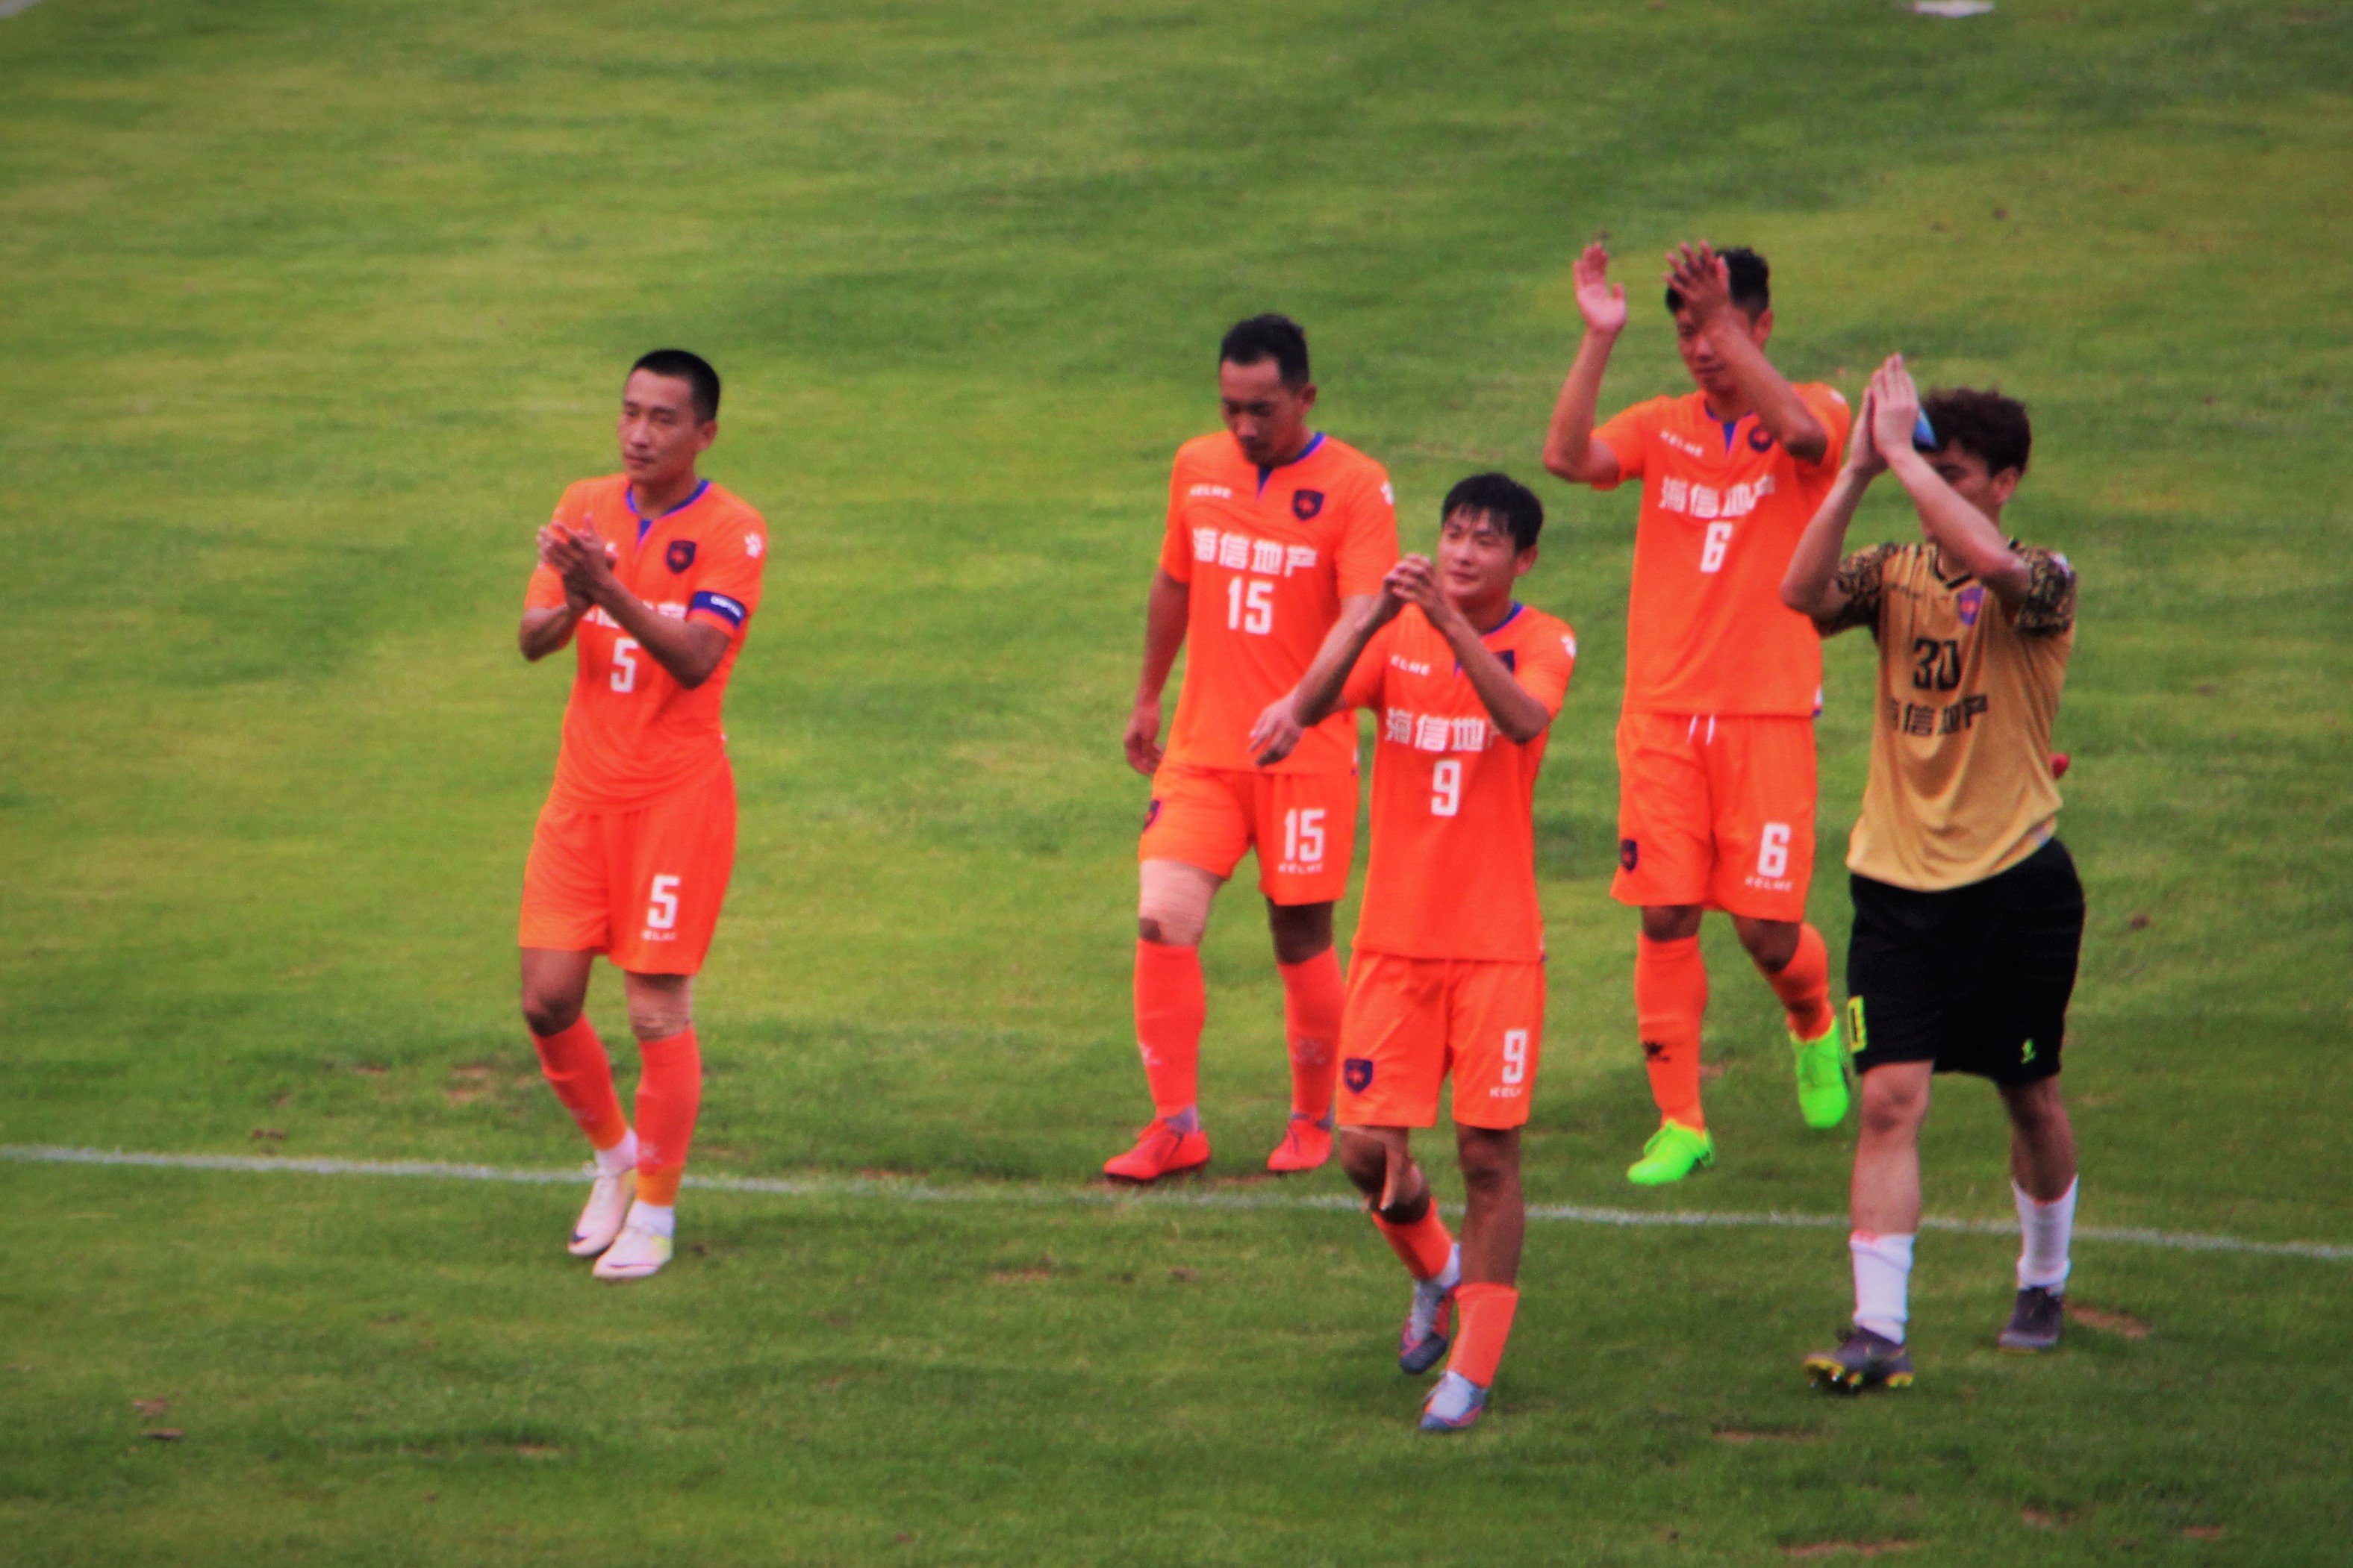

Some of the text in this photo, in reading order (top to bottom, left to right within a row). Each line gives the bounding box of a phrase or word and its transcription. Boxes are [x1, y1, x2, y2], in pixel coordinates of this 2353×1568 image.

[1192, 528, 1317, 578] 海信地产
[1700, 521, 1733, 573] 6
[1228, 576, 1273, 634] 15
[611, 637, 638, 693] 5
[1913, 637, 1960, 691] 30
[1431, 760, 1461, 816] 9
[1284, 808, 1325, 861] 15
[1757, 822, 1790, 878] 6
[646, 874, 679, 928] 5
[1502, 1029, 1527, 1084] 9
